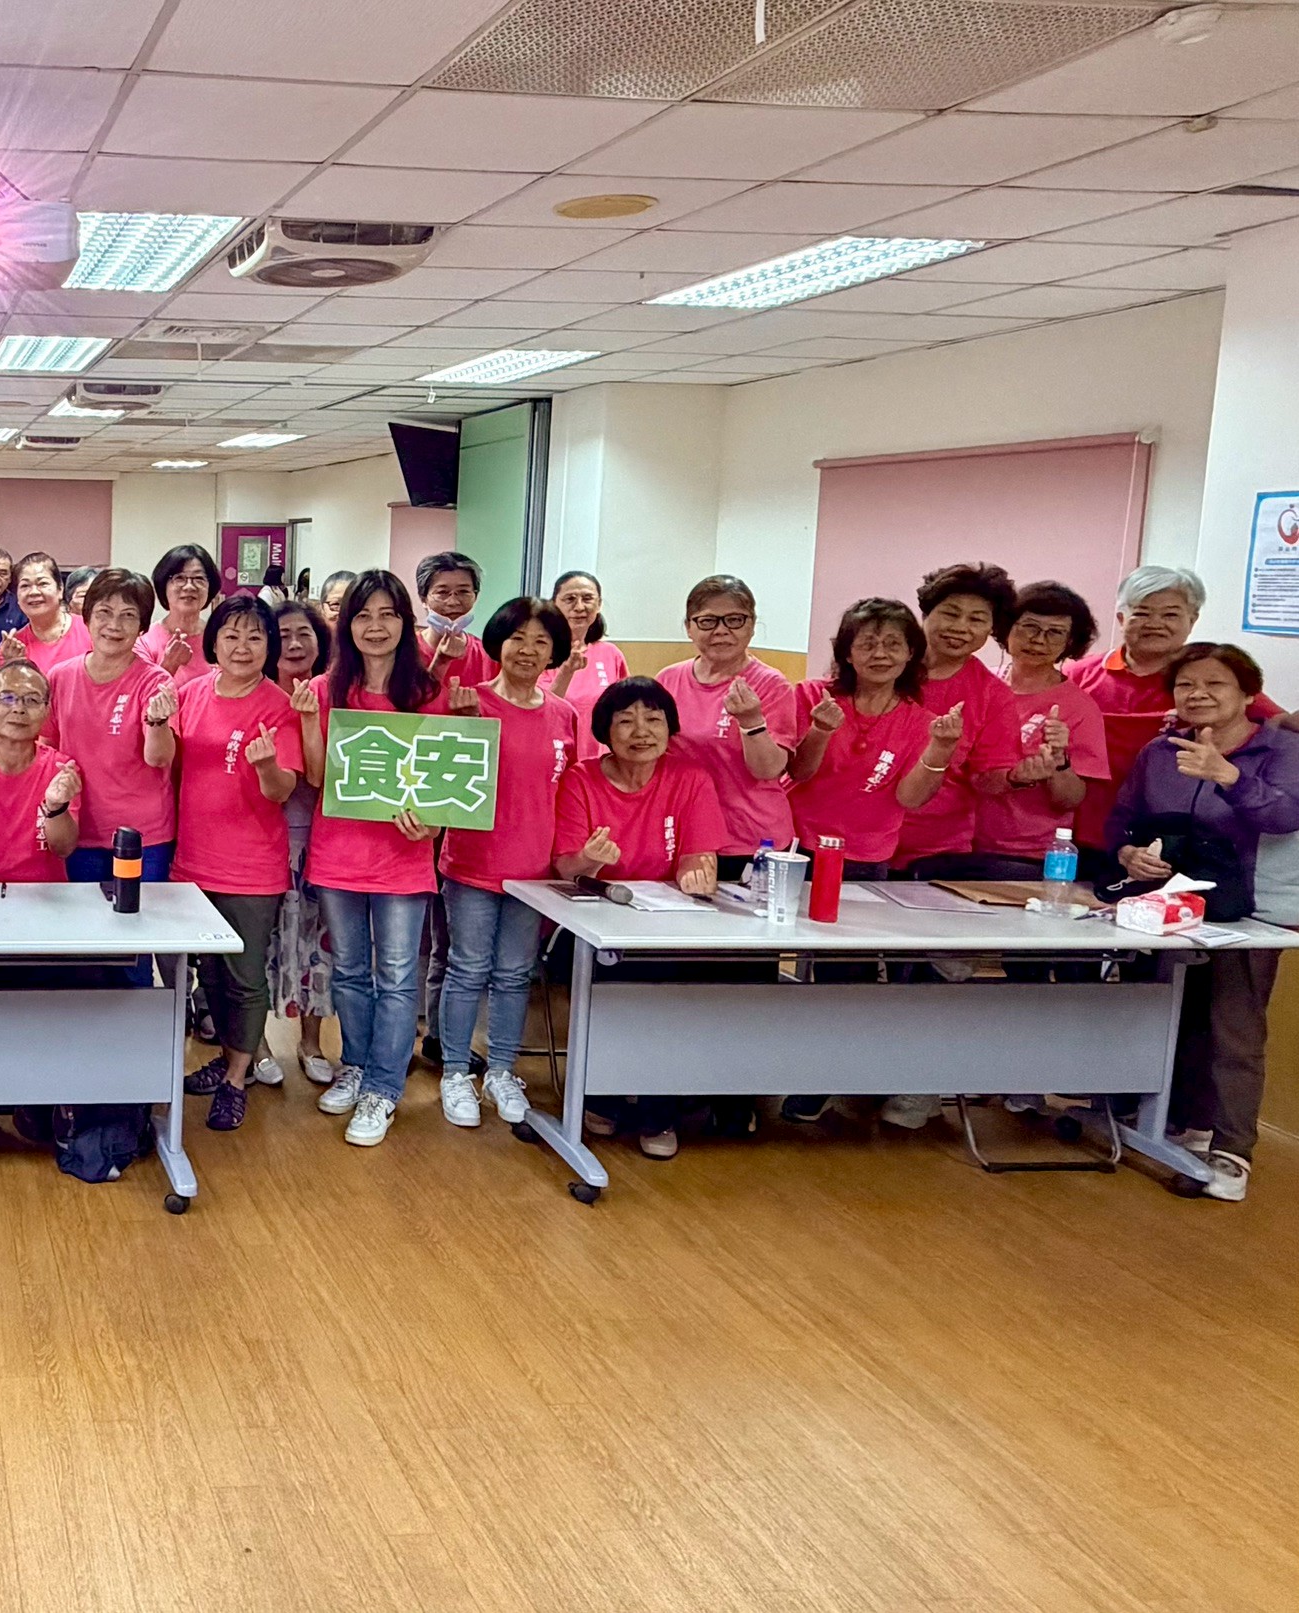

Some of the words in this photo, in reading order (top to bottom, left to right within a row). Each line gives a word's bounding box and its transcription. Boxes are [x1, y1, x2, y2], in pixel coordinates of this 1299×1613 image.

[108, 693, 130, 735] 廉政志工
[224, 729, 245, 774] 廉政志工
[336, 726, 489, 812] 食安
[551, 739, 565, 783] 廉政志工
[859, 750, 895, 793] 廉政志工
[664, 815, 676, 862] 廉政志工
